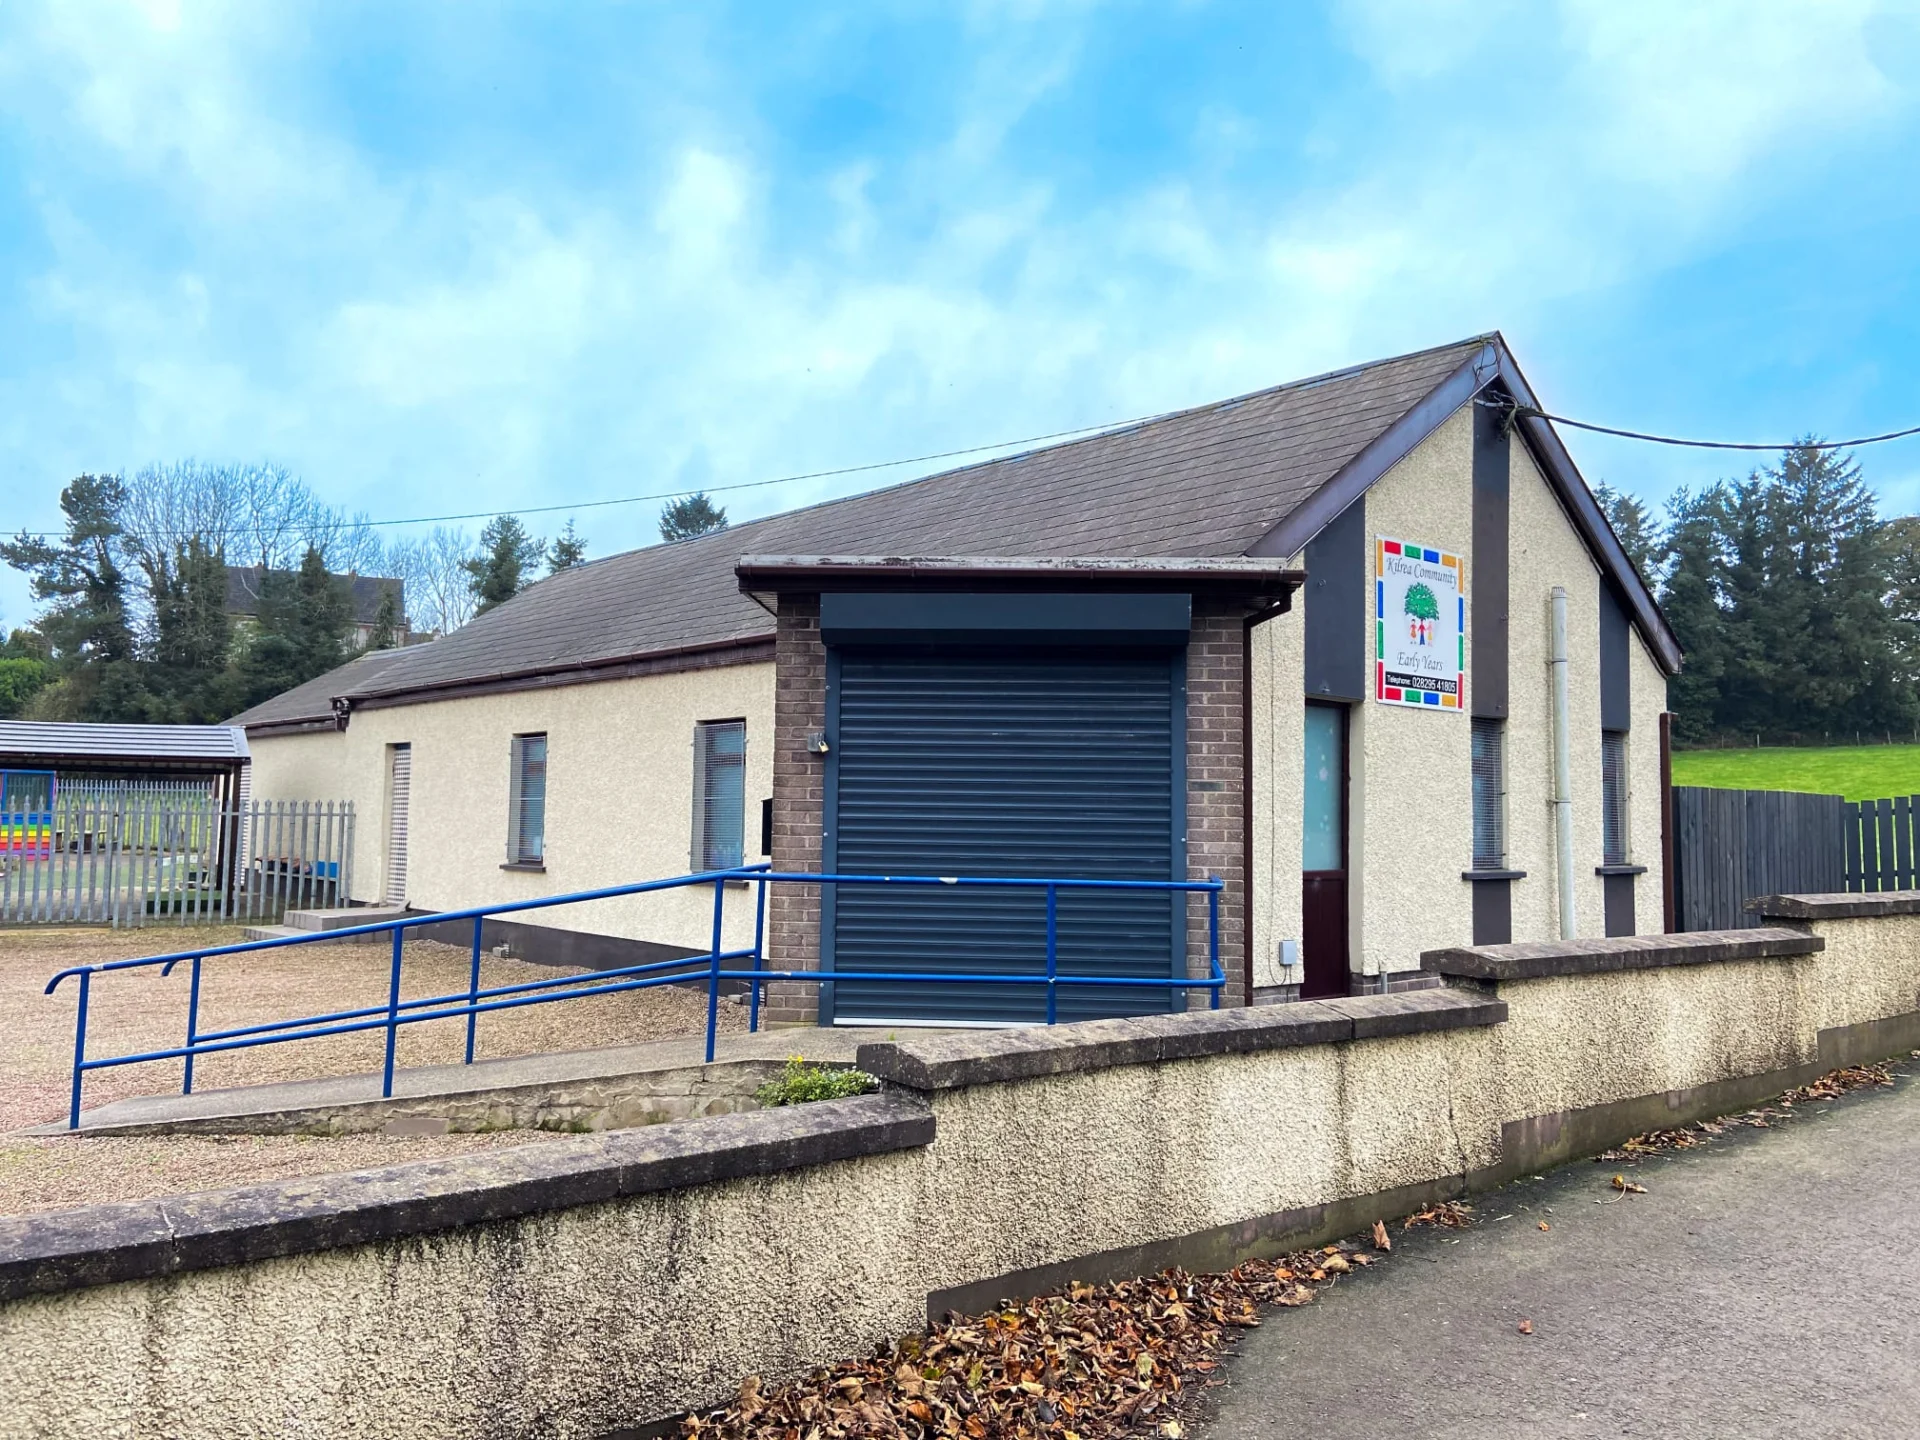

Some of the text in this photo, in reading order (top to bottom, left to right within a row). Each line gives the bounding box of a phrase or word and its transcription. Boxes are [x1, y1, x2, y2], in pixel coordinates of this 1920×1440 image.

[1386, 557, 1457, 589] Kilrea Community
[1397, 651, 1443, 672] Early Years
[1436, 680, 1456, 692] 41805
